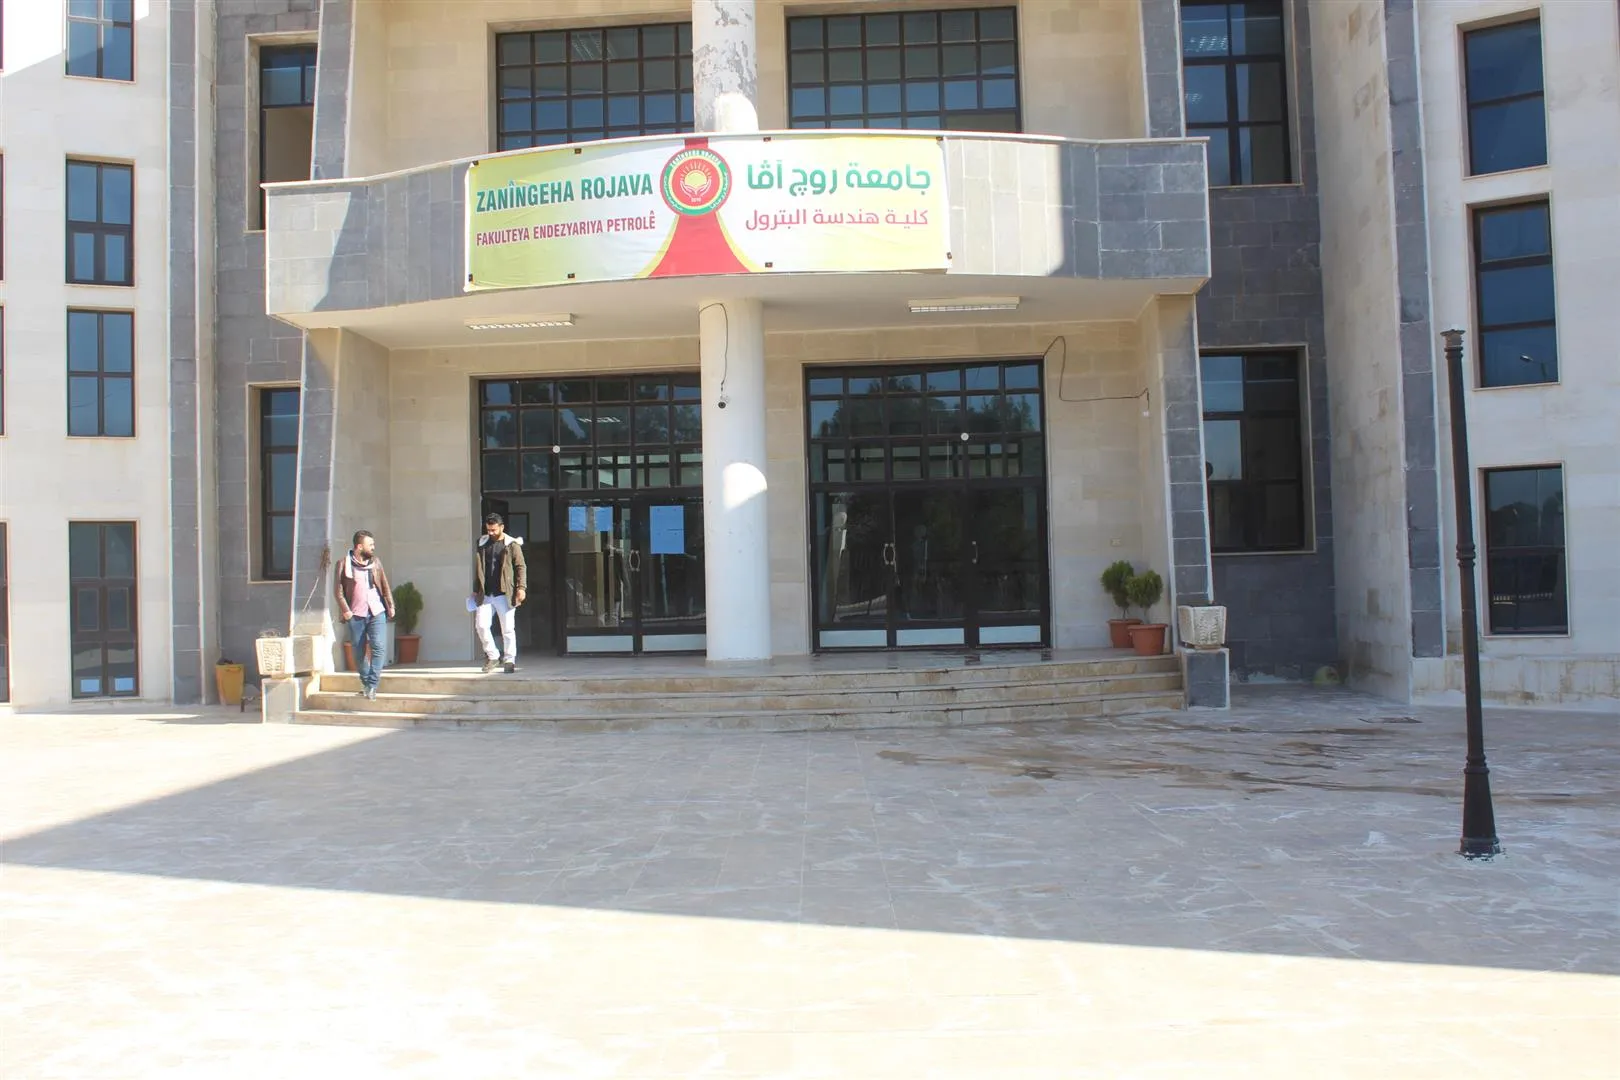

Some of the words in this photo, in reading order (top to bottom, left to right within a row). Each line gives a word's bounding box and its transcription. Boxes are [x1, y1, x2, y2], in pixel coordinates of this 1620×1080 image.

[747, 159, 783, 189] آڤا
[789, 169, 838, 196] روچ
[846, 162, 930, 195] جامعة
[476, 180, 574, 212] ZANÎNGEHA
[581, 173, 653, 200] ROJAVA
[476, 227, 530, 246] FAKULTEYA
[533, 220, 603, 239] ENDEZYARIYA
[607, 210, 656, 232] PETROLÊ
[745, 208, 807, 231] البترول
[813, 208, 879, 224] هندسة
[885, 209, 928, 229] كلية
